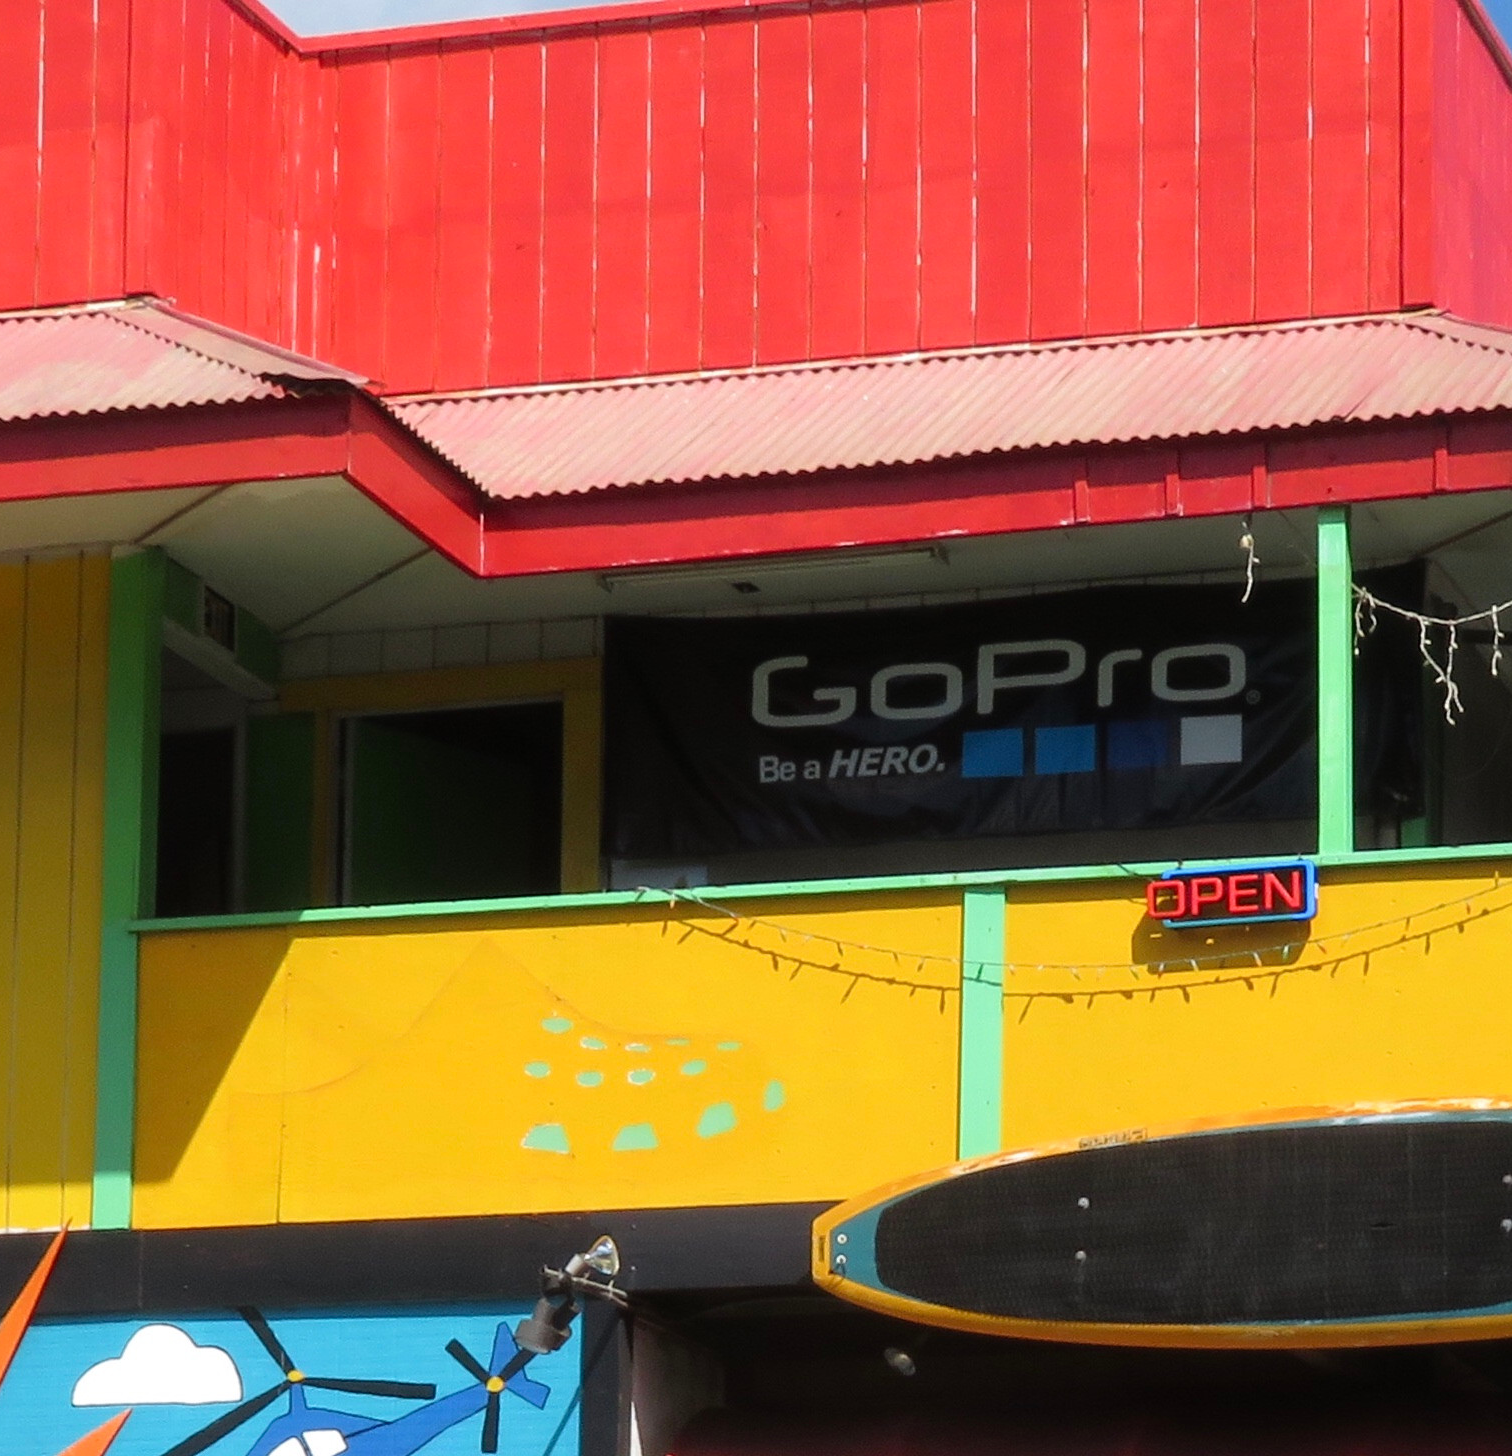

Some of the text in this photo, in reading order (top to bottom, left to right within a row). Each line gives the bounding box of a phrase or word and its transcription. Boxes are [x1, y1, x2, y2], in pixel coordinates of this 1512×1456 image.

[752, 639, 1246, 728] GoPro
[759, 744, 946, 784] Be a HERO.
[1147, 870, 1302, 919] OPEN
